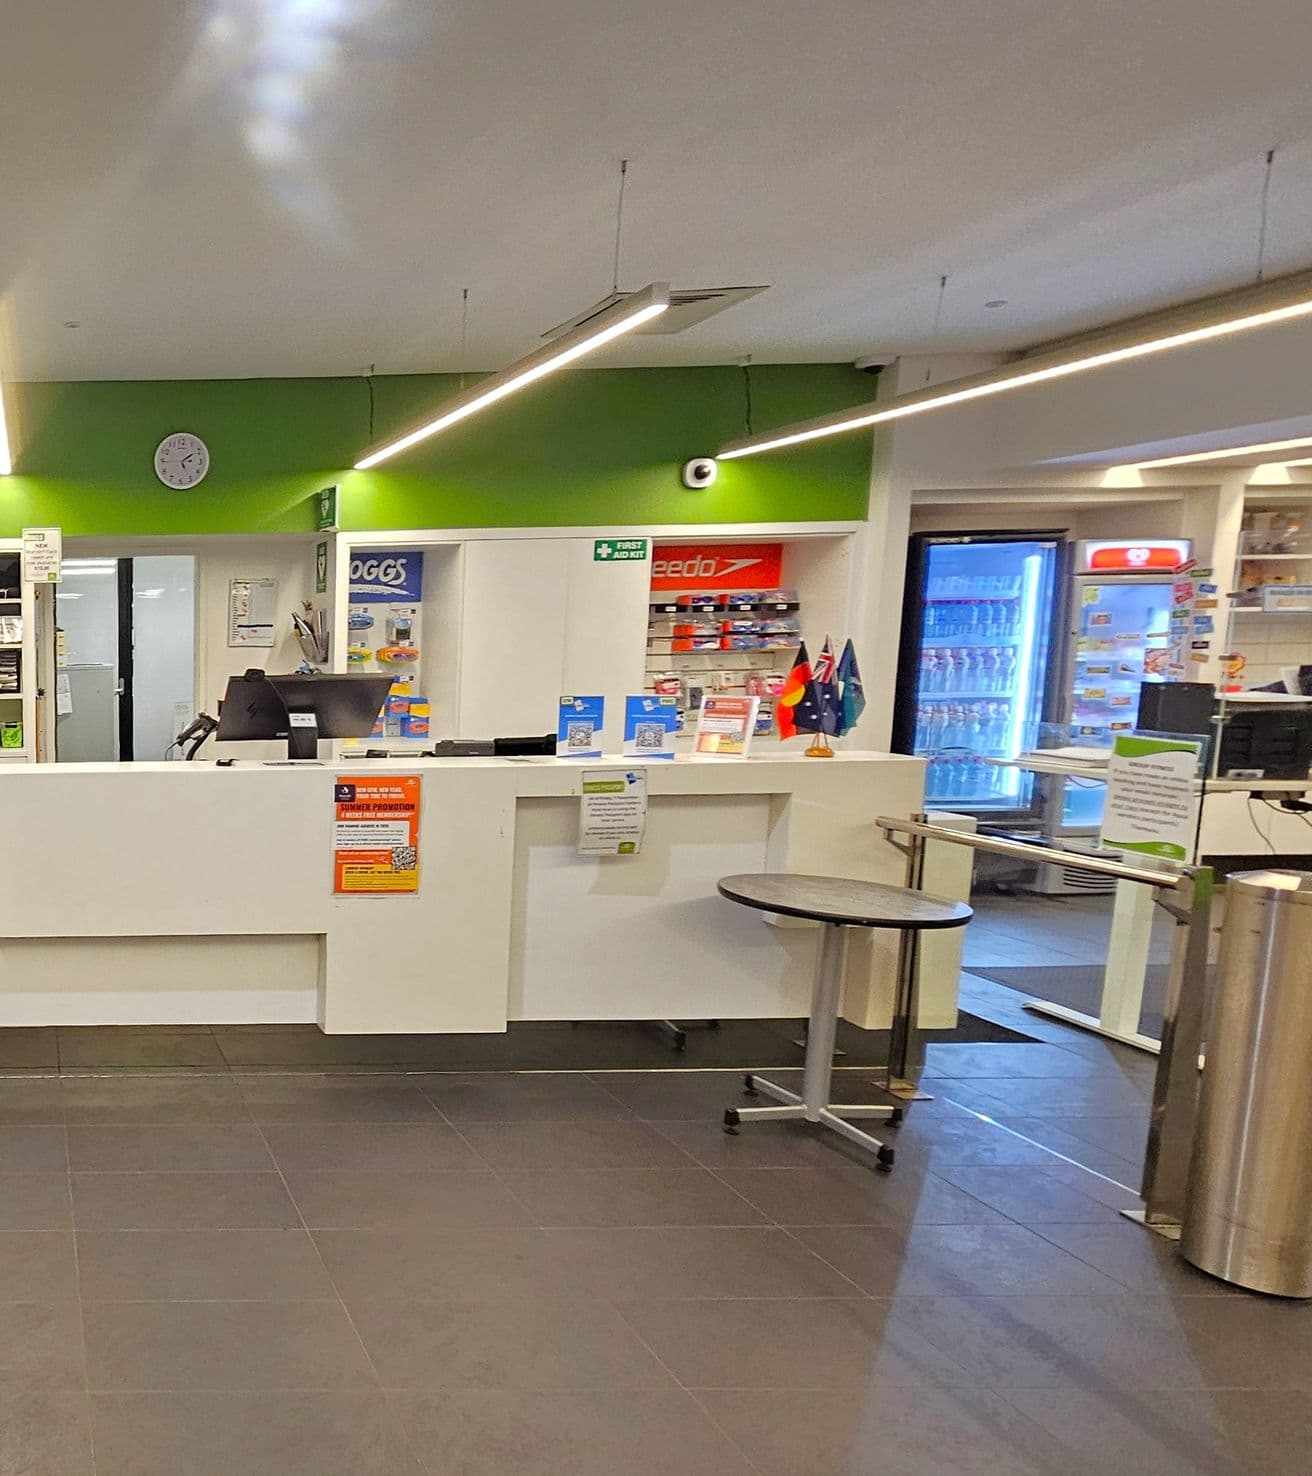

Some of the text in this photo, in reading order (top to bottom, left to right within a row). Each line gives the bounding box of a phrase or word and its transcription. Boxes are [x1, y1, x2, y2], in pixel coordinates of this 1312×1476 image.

[616, 542, 642, 550] FIRST
[613, 550, 644, 559] AID KIT
[652, 554, 716, 578] eedo
[349, 557, 407, 586] OGGS
[341, 802, 416, 812] SUMMER PROMOTION
